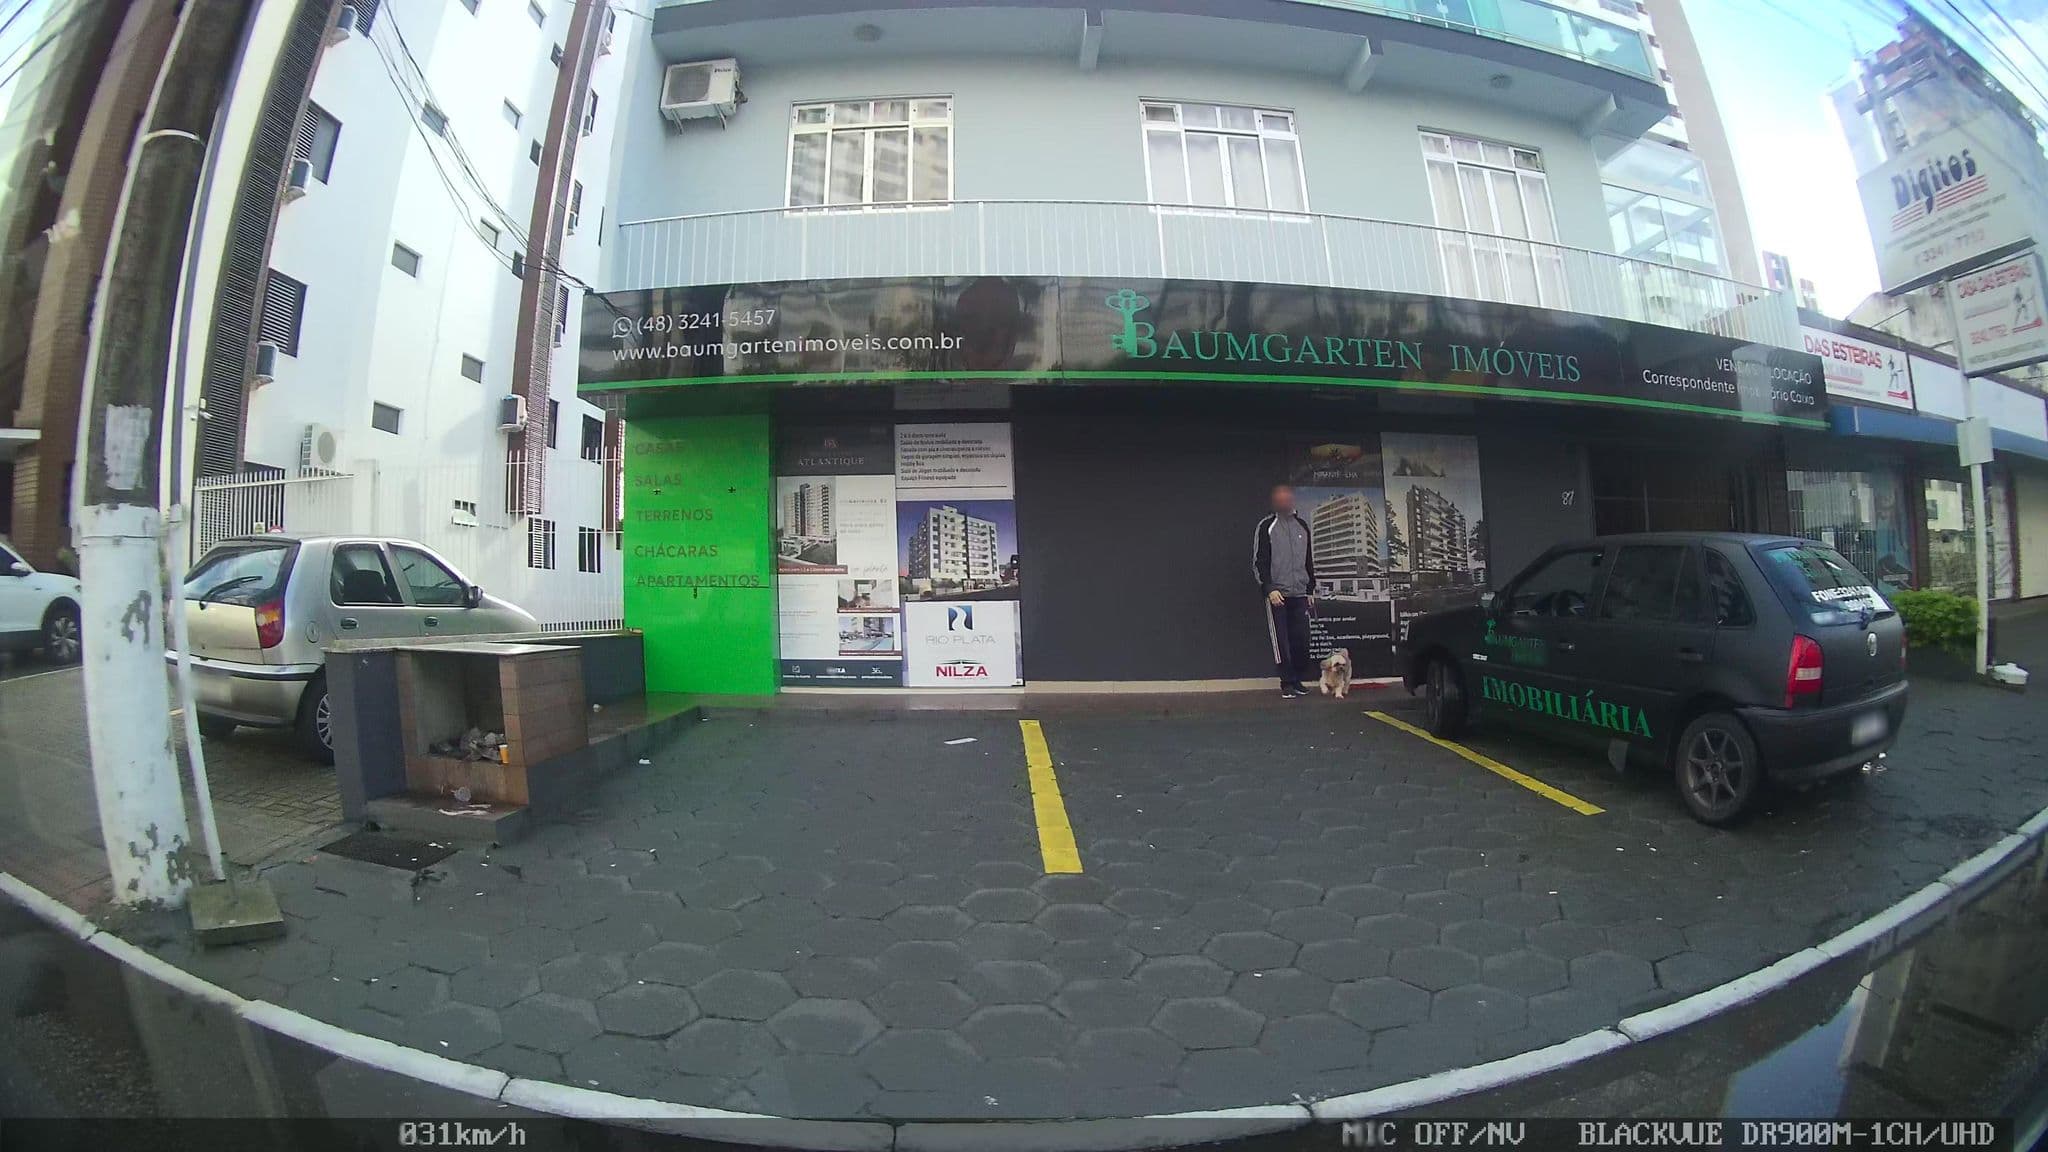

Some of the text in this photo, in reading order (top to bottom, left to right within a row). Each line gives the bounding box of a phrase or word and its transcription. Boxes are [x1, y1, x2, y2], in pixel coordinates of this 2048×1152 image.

[636, 309, 776, 335] (48) 3241-5457
[612, 333, 963, 361] www.baumgartenimoveis.com.br
[1131, 321, 1581, 383] BAUMGARTEN IMÓVEIS
[1804, 335, 1830, 357] DAS
[1642, 369, 1736, 395] Correspondente
[799, 456, 865, 466] ATLANTIQUE
[634, 475, 682, 488] SALAS
[635, 508, 714, 522] TERRENOS
[633, 544, 719, 558] CHÁCARAS
[636, 574, 761, 588] APARTAMENTOS
[925, 633, 997, 646] RIO PLATA
[935, 665, 988, 677] NILZA
[1482, 675, 1654, 739] IMOBILIÁRIA
